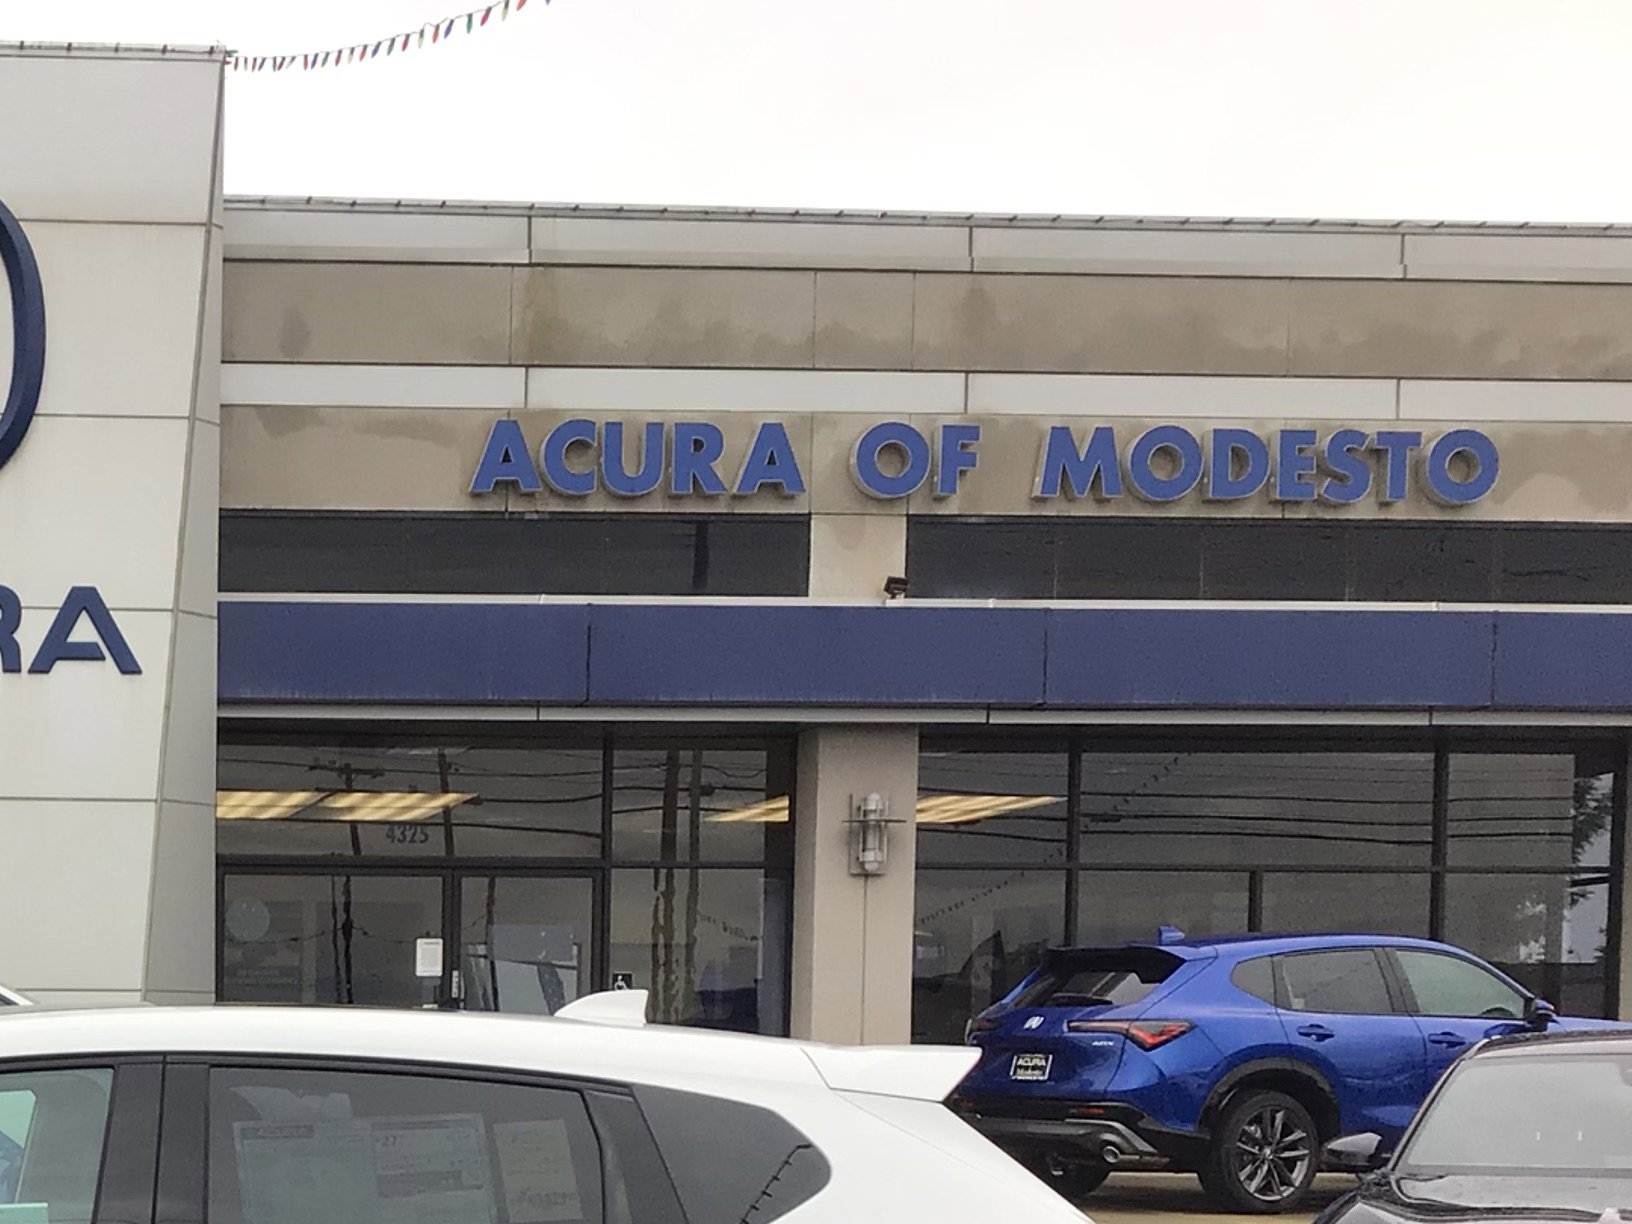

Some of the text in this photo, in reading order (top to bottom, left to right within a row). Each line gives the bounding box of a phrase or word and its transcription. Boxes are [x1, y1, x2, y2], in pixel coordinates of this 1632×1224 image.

[469, 418, 1500, 503] ACURA OF MODESTO
[386, 824, 429, 844] 4325
[1017, 1057, 1047, 1066] ACURA
